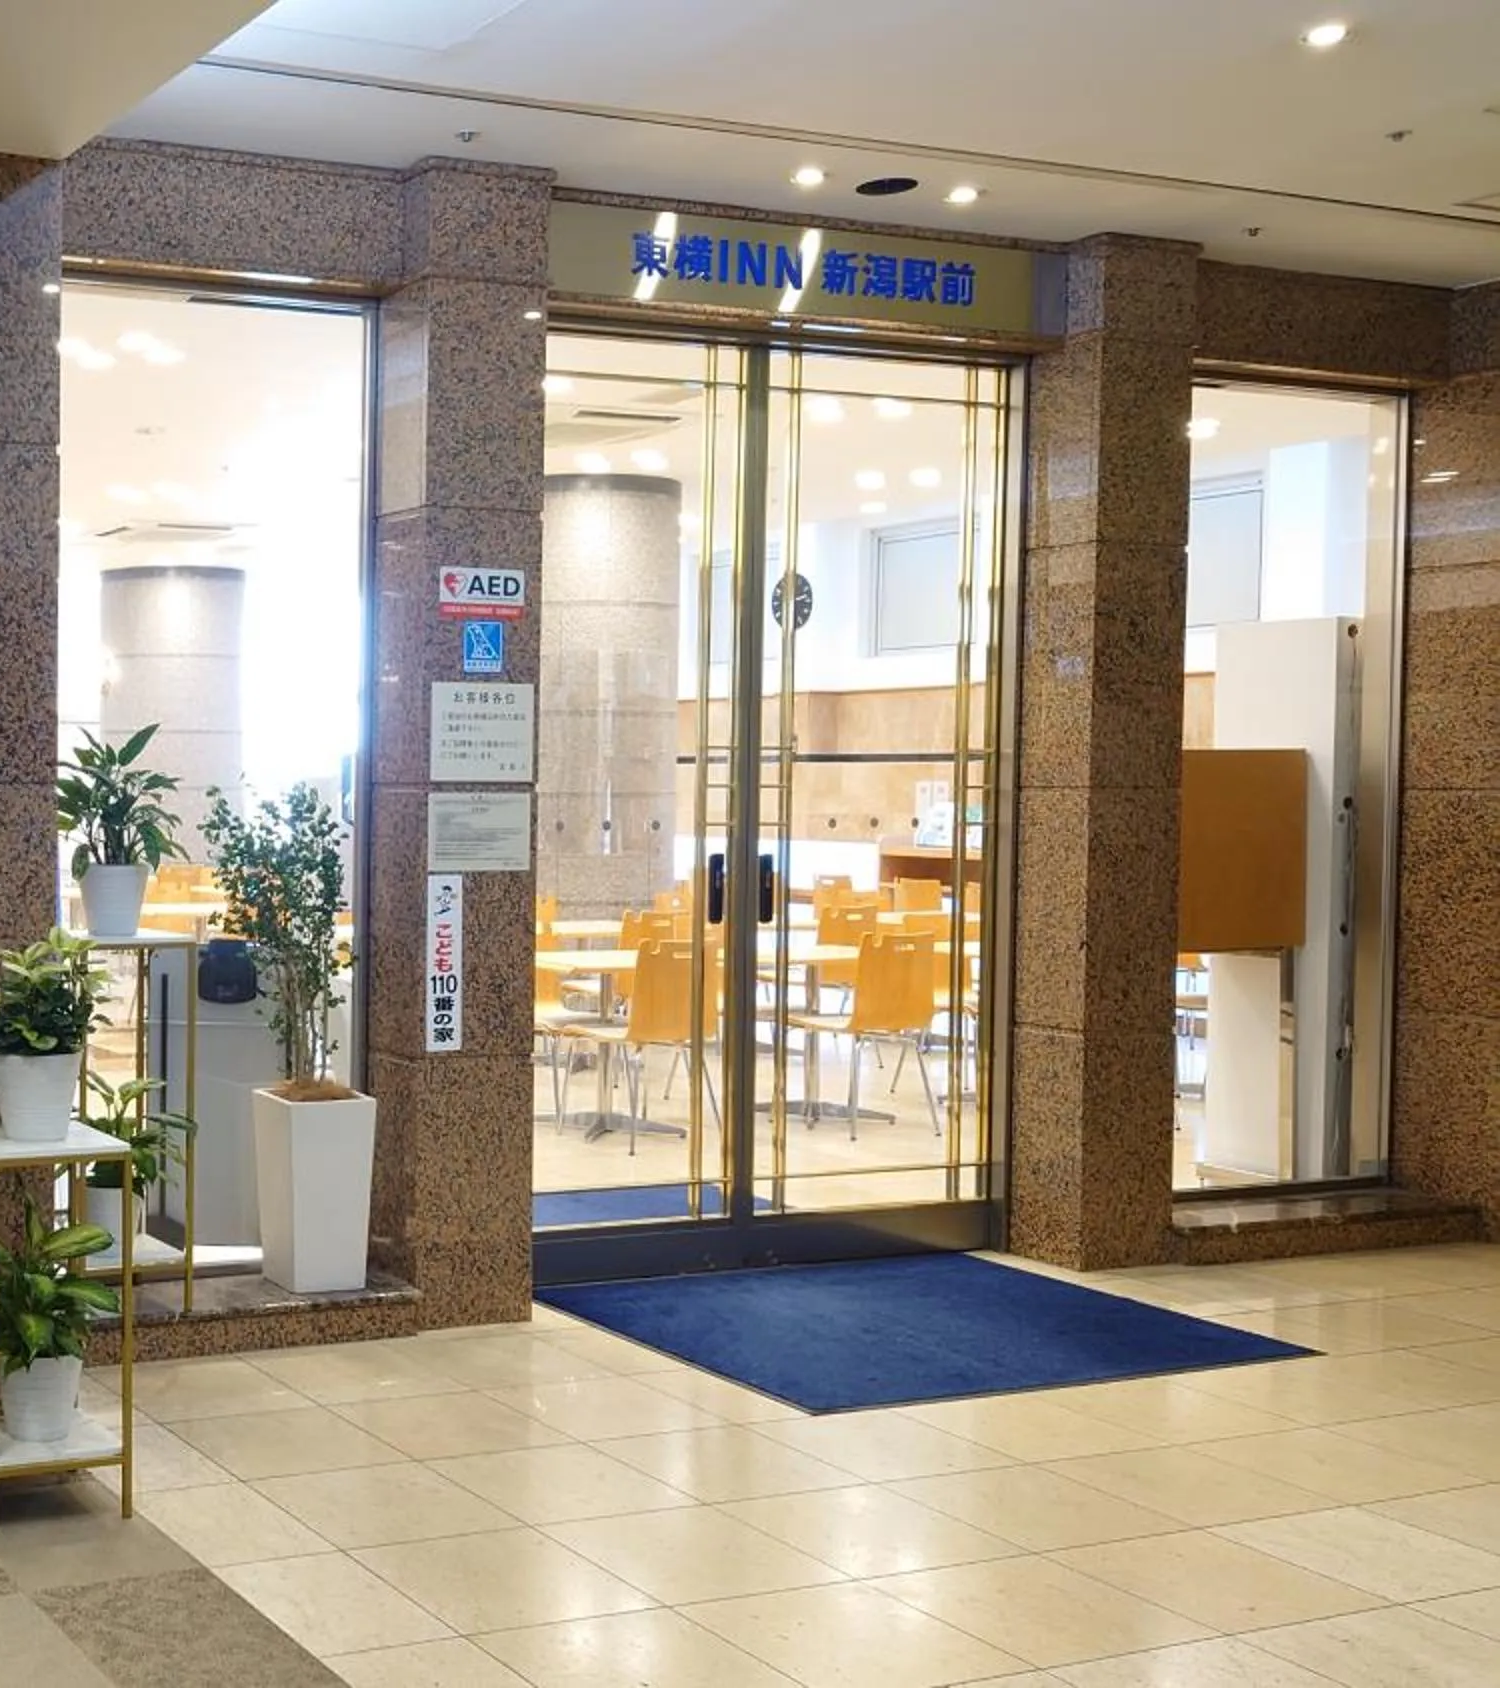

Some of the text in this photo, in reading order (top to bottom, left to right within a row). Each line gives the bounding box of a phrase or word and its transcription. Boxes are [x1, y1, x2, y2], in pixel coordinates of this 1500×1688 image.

[631, 232, 976, 306] 東横INN 新潟駅前
[467, 575, 521, 597] AED
[430, 923, 459, 1042] こども110番の家
